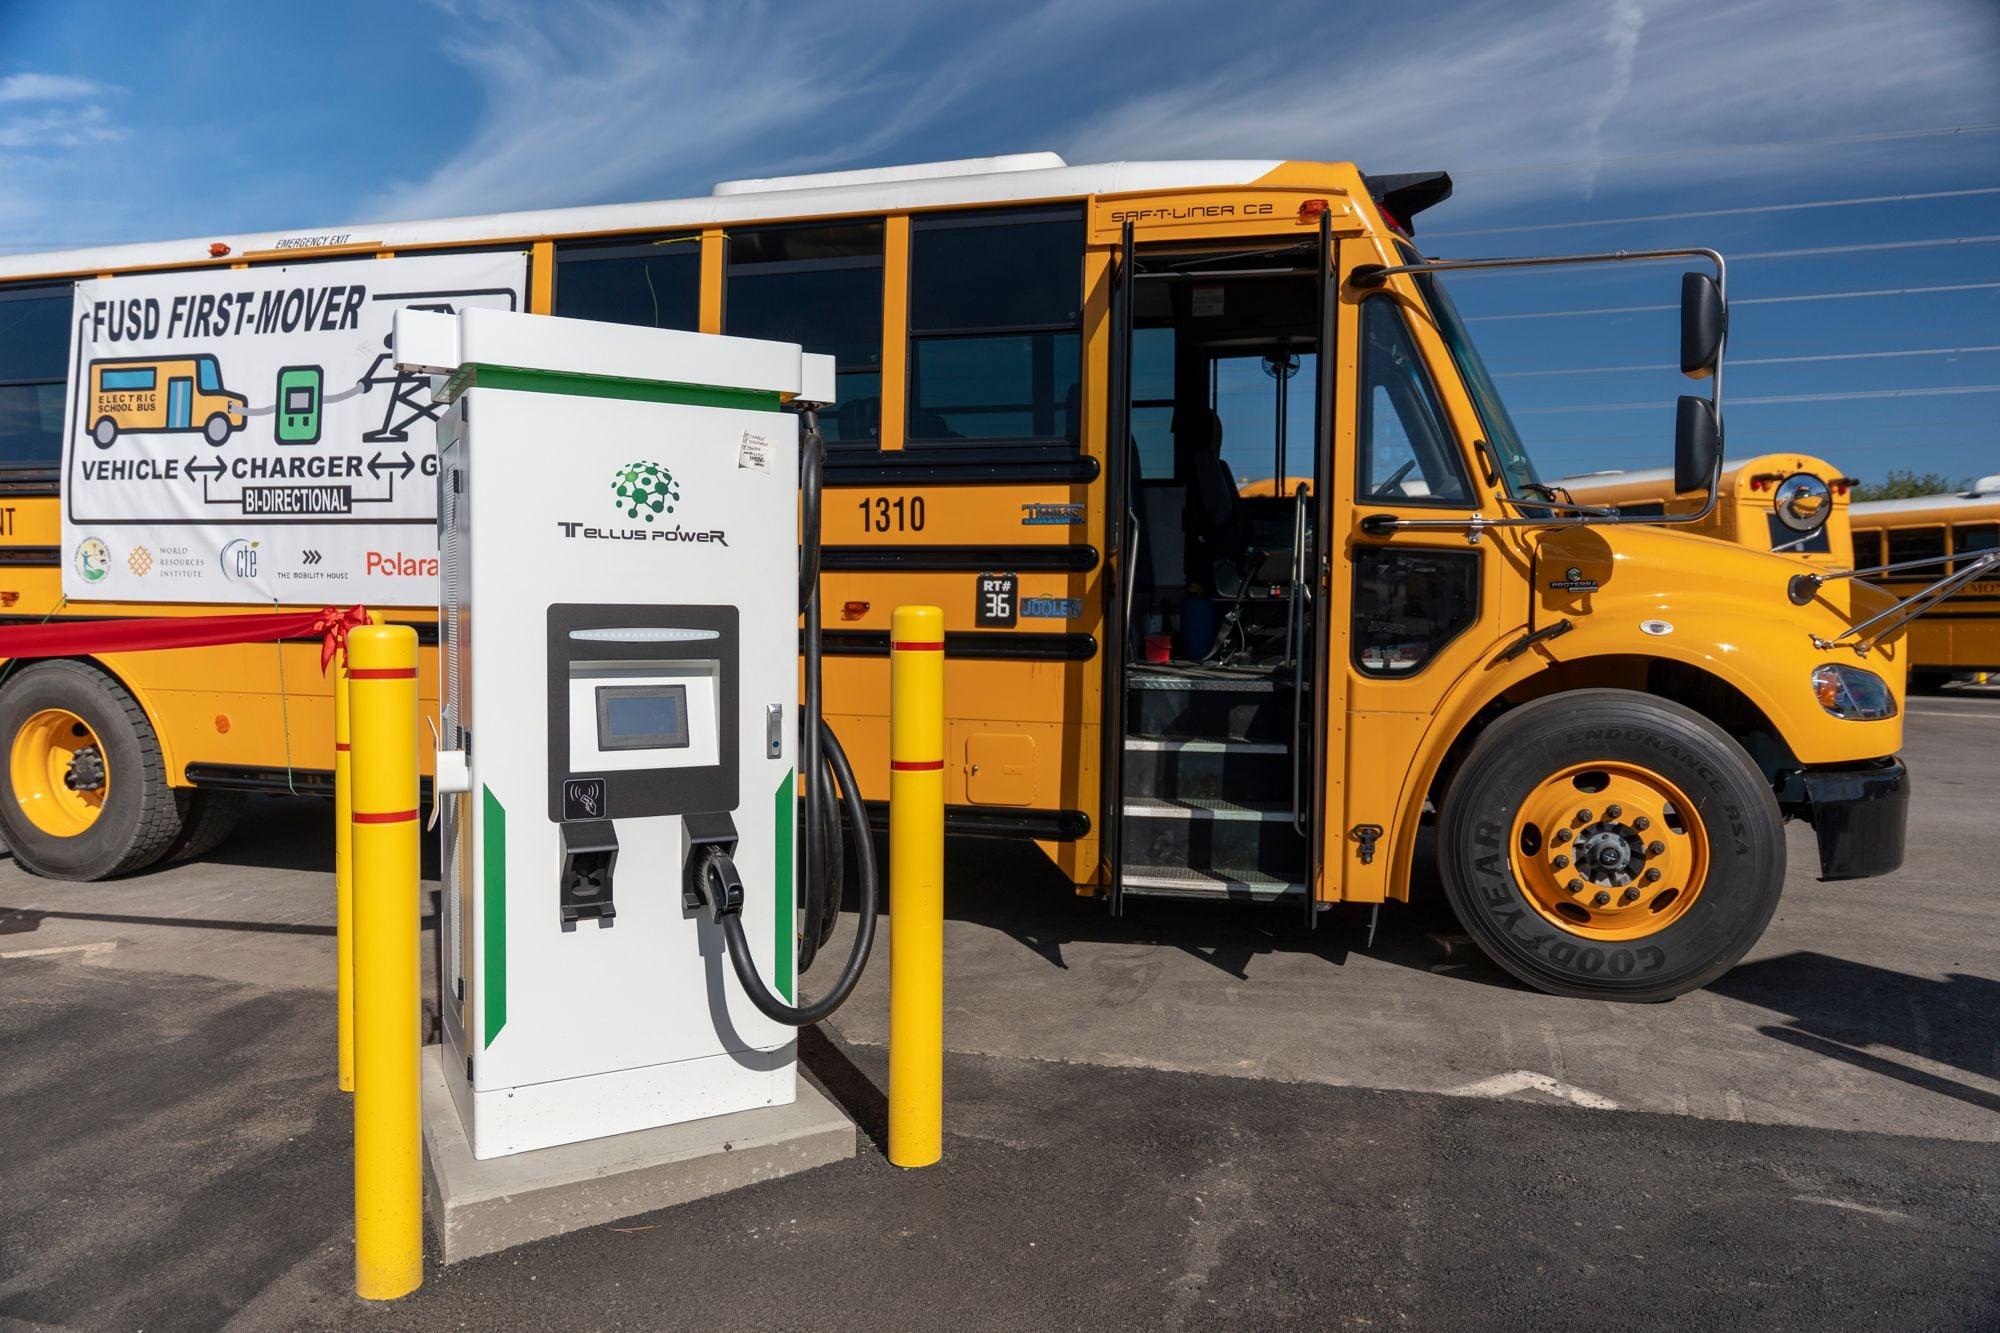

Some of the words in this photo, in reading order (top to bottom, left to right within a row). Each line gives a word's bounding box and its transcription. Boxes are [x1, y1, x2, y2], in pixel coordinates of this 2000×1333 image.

[1243, 204, 1273, 215] C2
[276, 236, 329, 249] EMERGENCY
[330, 234, 351, 245] EXIT
[92, 298, 160, 343] FUSD
[167, 285, 366, 339] FIRST-MOVER
[98, 393, 156, 404] ELECTRIC
[98, 403, 133, 413] SCHOOL
[137, 403, 156, 412] BUS
[82, 459, 179, 481] VEHICLE
[231, 455, 363, 479] CHARGER
[245, 488, 348, 512] BI-DIRECTIONAL
[859, 496, 925, 532] 1310
[160, 547, 188, 555] WORLD
[160, 559, 205, 567] RESOURCES
[160, 570, 202, 578] INSTITUTE
[293, 572, 324, 580] MOBILITY
[327, 572, 349, 580] HOUSE
[983, 580, 1011, 592] RT#
[986, 594, 1010, 618] 36
[1565, 728, 1727, 795] ENDURANCE
[1723, 804, 1748, 856] RSA
